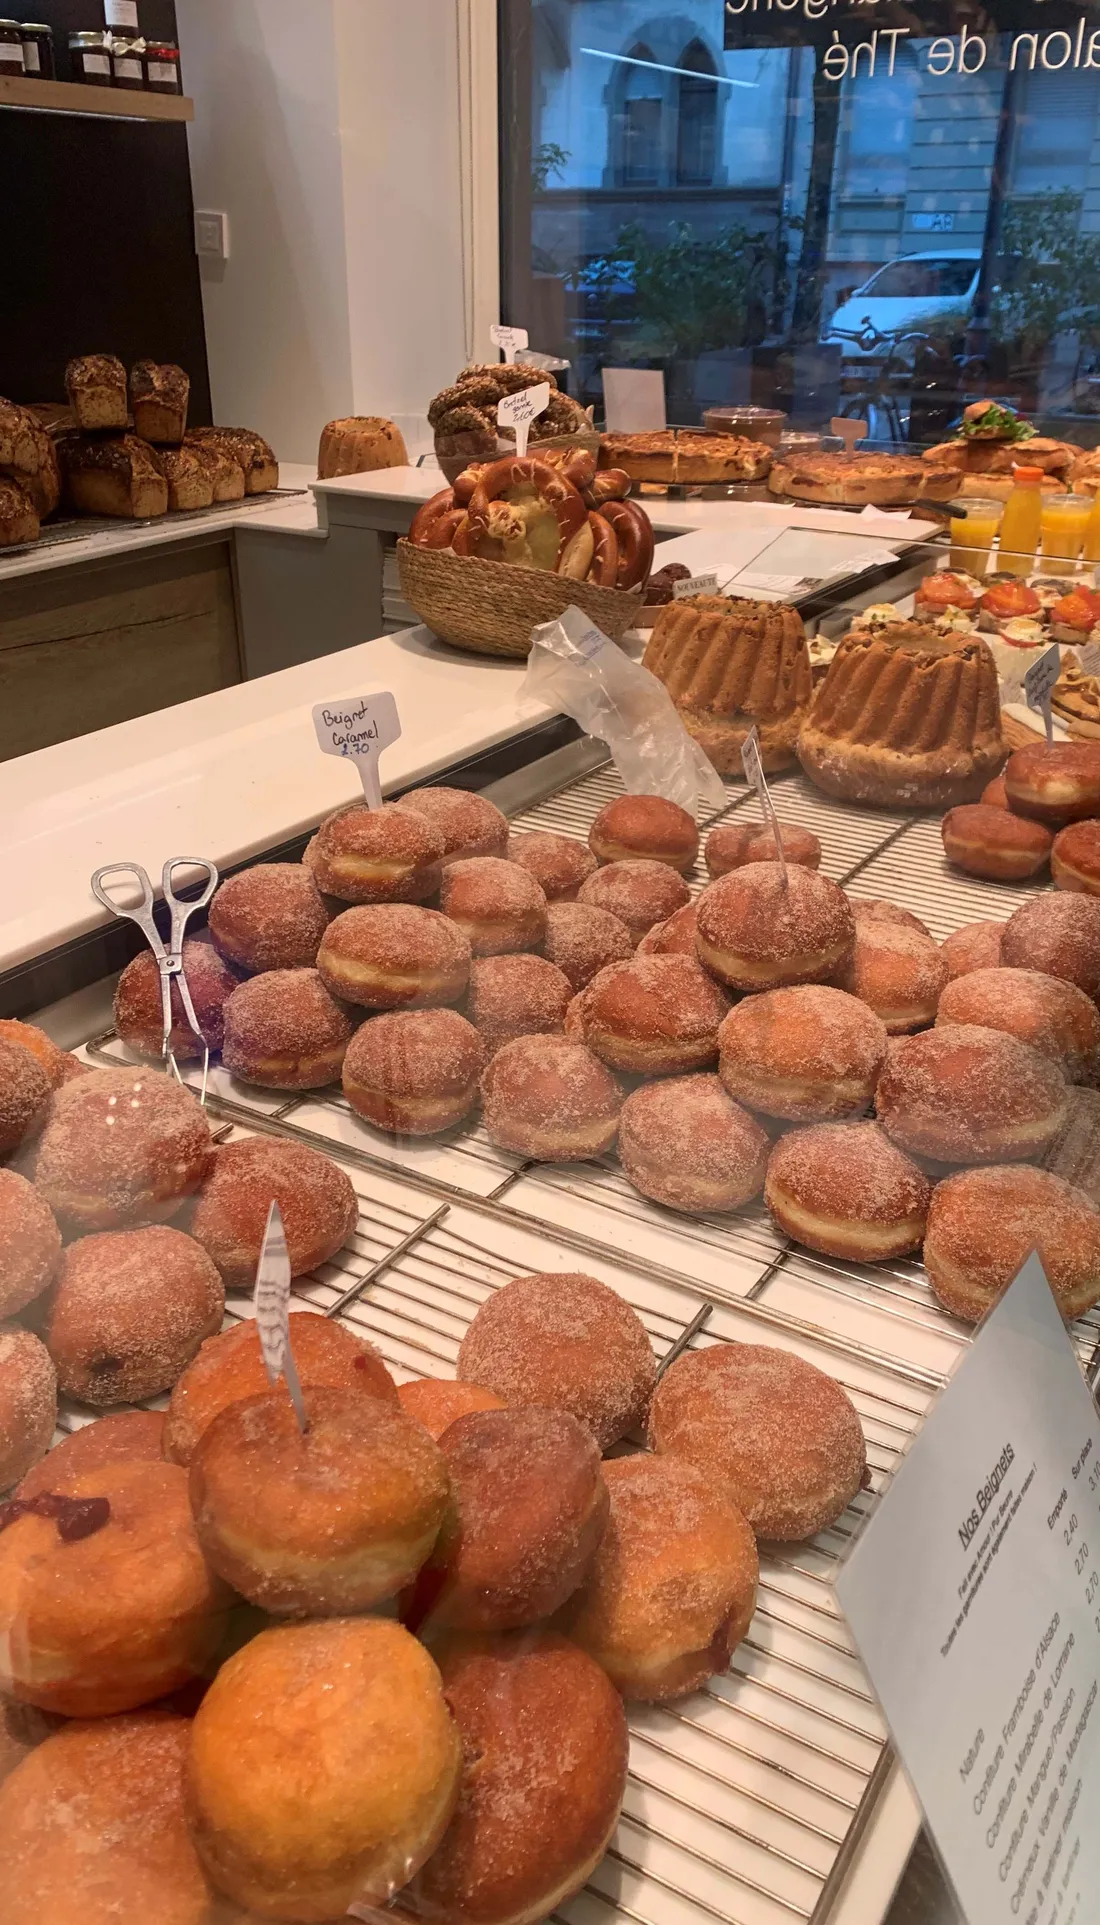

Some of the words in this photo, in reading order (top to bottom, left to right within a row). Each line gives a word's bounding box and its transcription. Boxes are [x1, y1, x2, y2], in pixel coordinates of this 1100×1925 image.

[332, 719, 379, 746] Caramel
[1072, 1459, 1081, 1480] Sur
[1080, 1437, 1093, 1467] place
[958, 1508, 981, 1552] Nos
[976, 1443, 1015, 1515] Beignets
[976, 1533, 991, 1561] Amour
[991, 1513, 1000, 1532] Pur
[1063, 1513, 1078, 1546] 2,40
[1074, 1542, 1089, 1576] 2,70
[1085, 1571, 1099, 1605] 2,70
[959, 1727, 985, 1784] Nature
[973, 1744, 1005, 1815] Confiture
[1002, 1668, 1036, 1745] Framboise
[986, 1776, 1017, 1848] Confiture
[1014, 1708, 1044, 1777] Mirabelle
[1043, 1686, 1053, 1710] de
[1050, 1632, 1075, 1689] Lorraine
[1059, 1763, 1070, 1788] de
[1066, 1679, 1098, 1765] Madagascar
[999, 1808, 1029, 1883] Confiture
